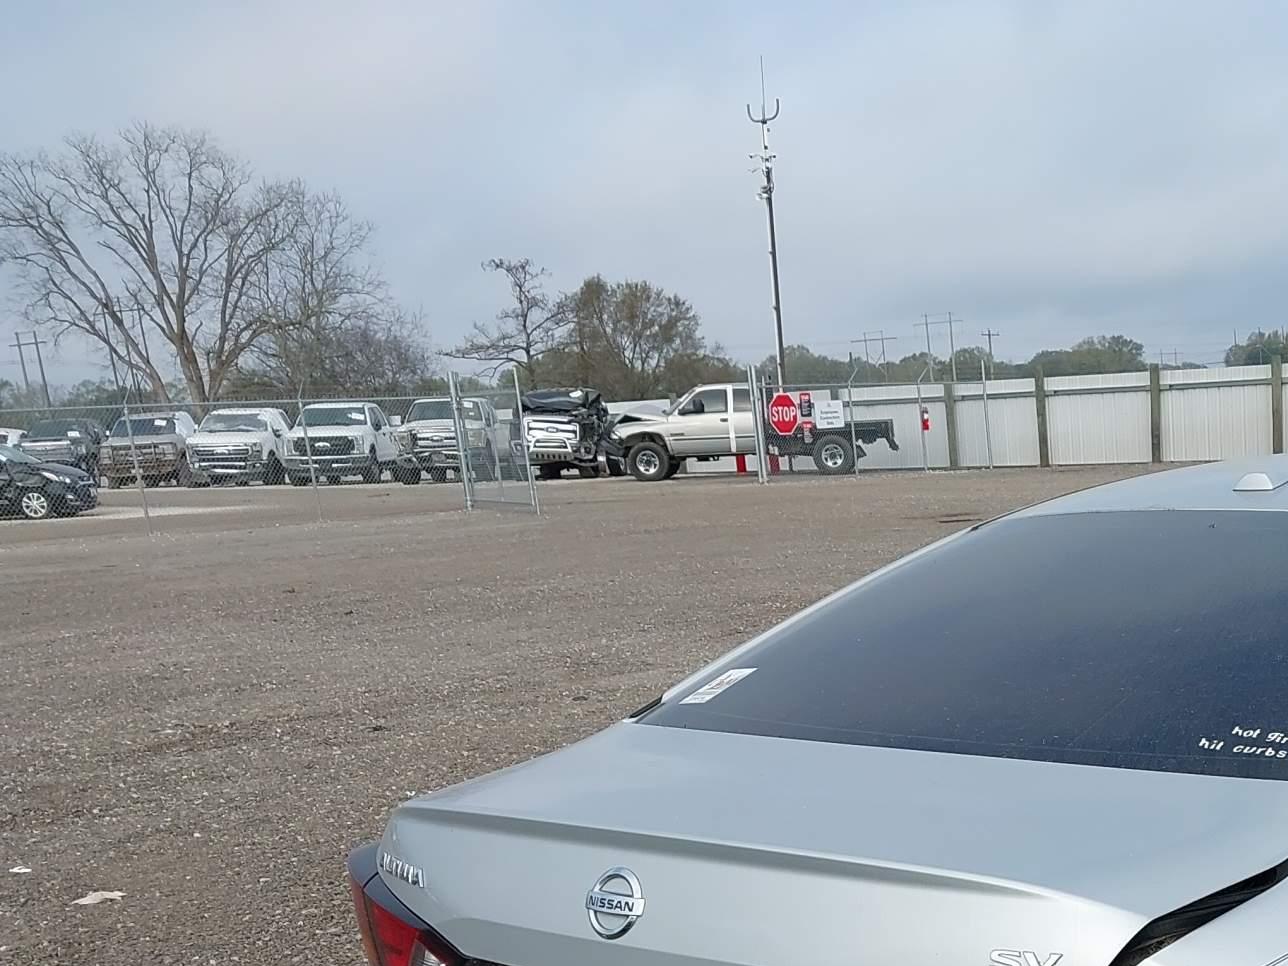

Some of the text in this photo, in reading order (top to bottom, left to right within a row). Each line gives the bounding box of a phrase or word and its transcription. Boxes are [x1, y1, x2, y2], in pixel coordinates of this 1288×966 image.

[772, 406, 796, 422] STOP
[1232, 726, 1261, 738] hot
[1199, 738, 1288, 759] hit curbs
[588, 895, 635, 912] NISSAN
